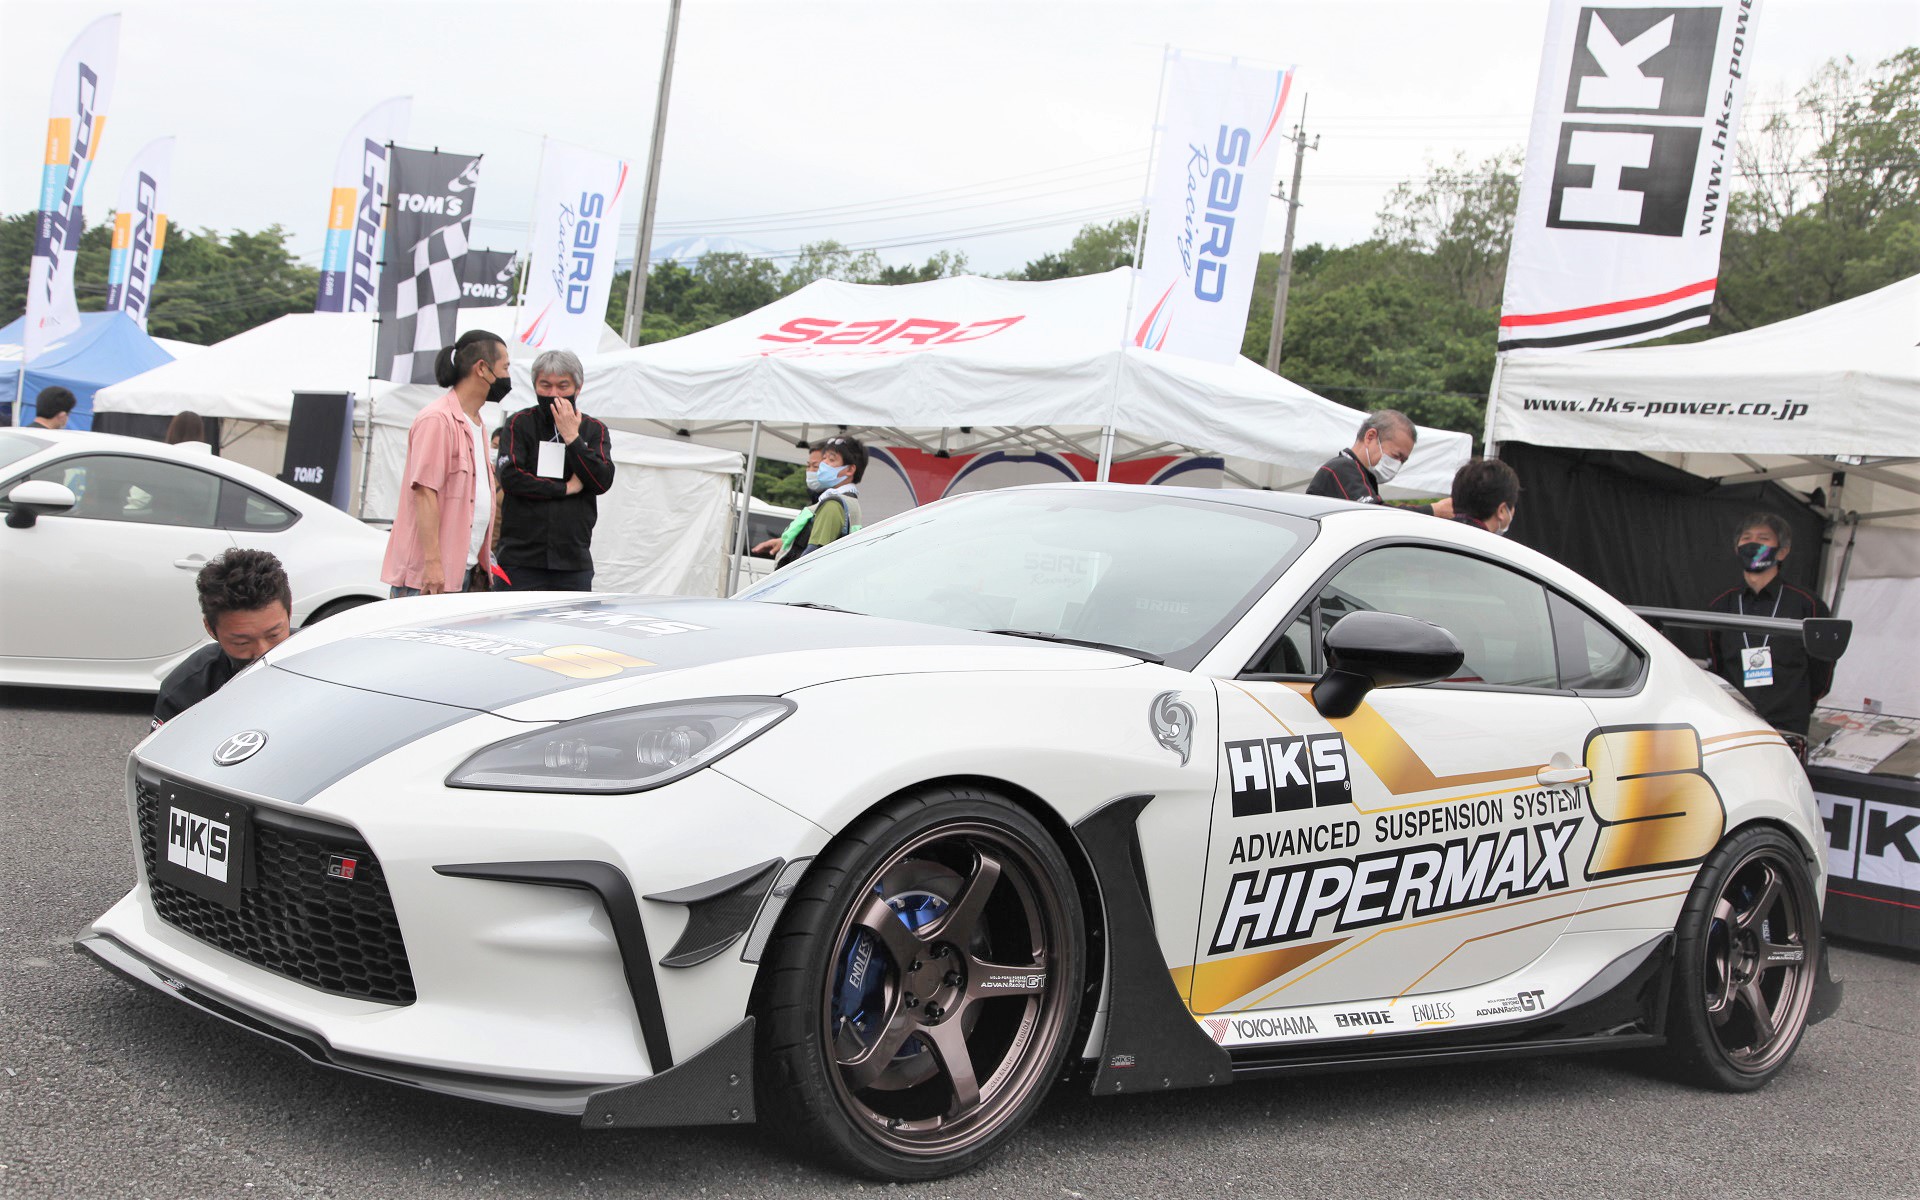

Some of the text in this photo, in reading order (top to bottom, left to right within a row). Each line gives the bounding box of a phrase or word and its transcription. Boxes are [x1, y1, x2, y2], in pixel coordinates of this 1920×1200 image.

[398, 193, 463, 217] TOM'S
[1177, 143, 1209, 278] Racing
[552, 202, 576, 299] Racing
[462, 282, 508, 299] TOM'S
[1523, 397, 1809, 420] www.hks-power.co.jp
[293, 466, 324, 483] TOM'S
[1229, 785, 1582, 865] ADVANCED SUSPENSION SYSTEM
[169, 810, 229, 870] HKS
[330, 864, 353, 878] GR
[1209, 818, 1583, 954] HIPERMAX
[1026, 974, 1046, 988] GT
[1517, 989, 1545, 1011] GT
[1334, 1010, 1394, 1028] BRIDE
[1412, 1002, 1455, 1022] ENDLESS
[1231, 1016, 1319, 1039] YOKOHAMA
